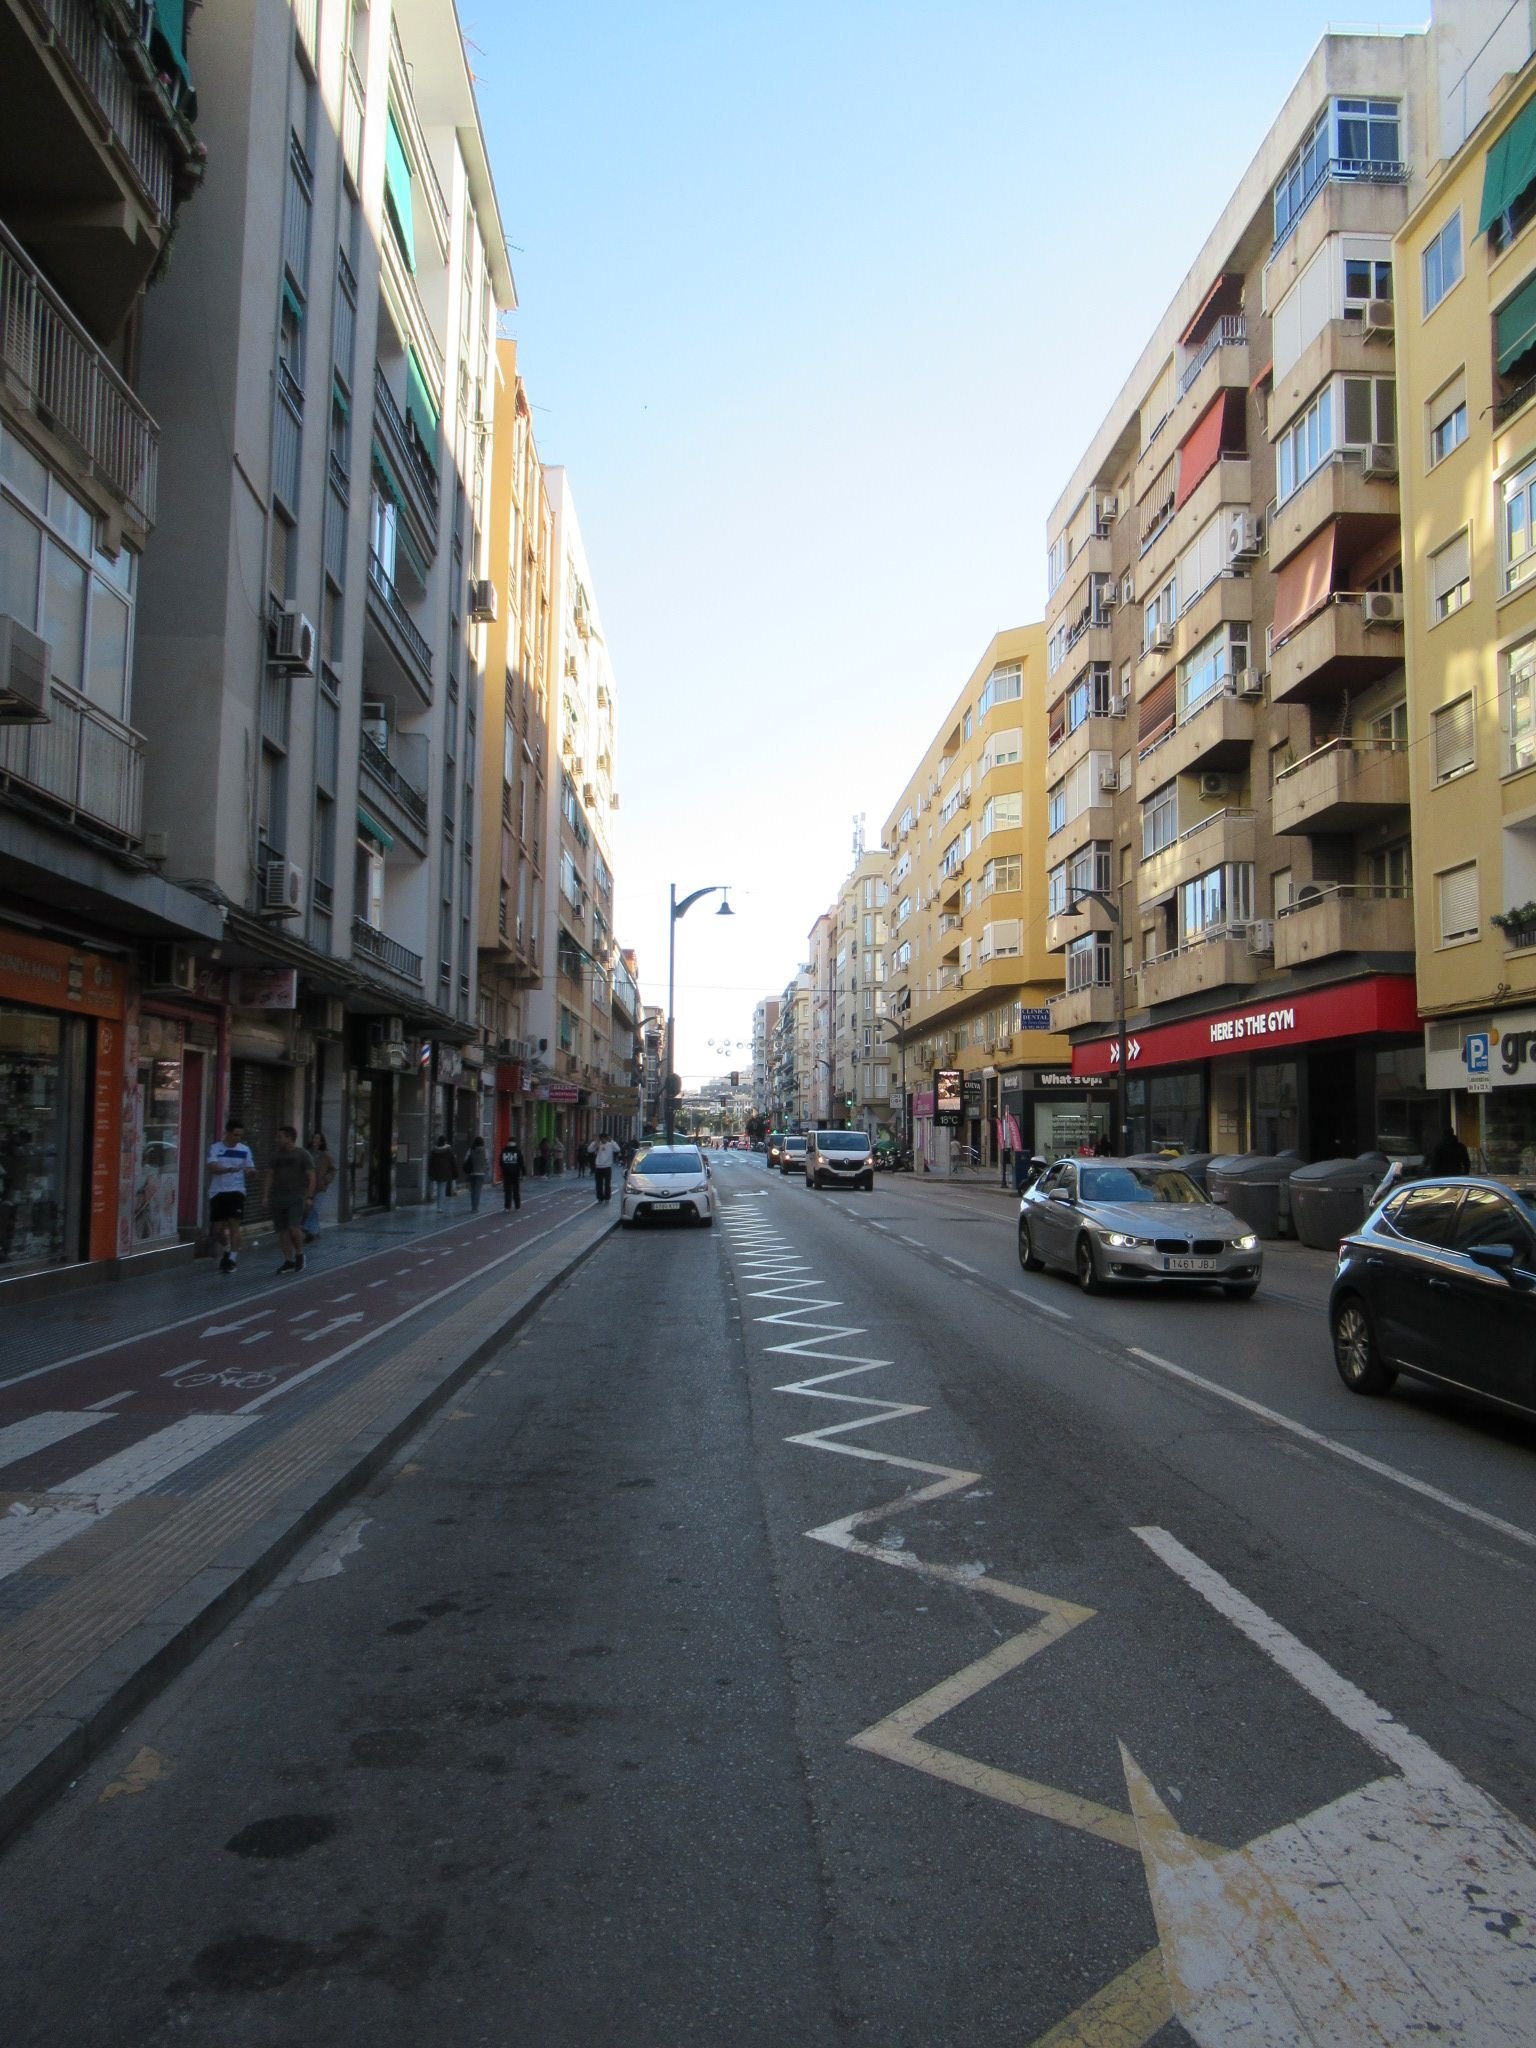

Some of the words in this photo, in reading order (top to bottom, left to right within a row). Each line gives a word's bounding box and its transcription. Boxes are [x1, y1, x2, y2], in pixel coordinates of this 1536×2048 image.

[1210, 1021, 1233, 1042] HERE
[1235, 1019, 1244, 1038] IS
[1245, 1014, 1266, 1036] THE
[1268, 1008, 1294, 1031] GYM
[1470, 1039, 1484, 1068] P
[964, 1082, 981, 1090] CUEVA
[1172, 1260, 1194, 1269] 1461
[1198, 1259, 1215, 1269] JBJ
